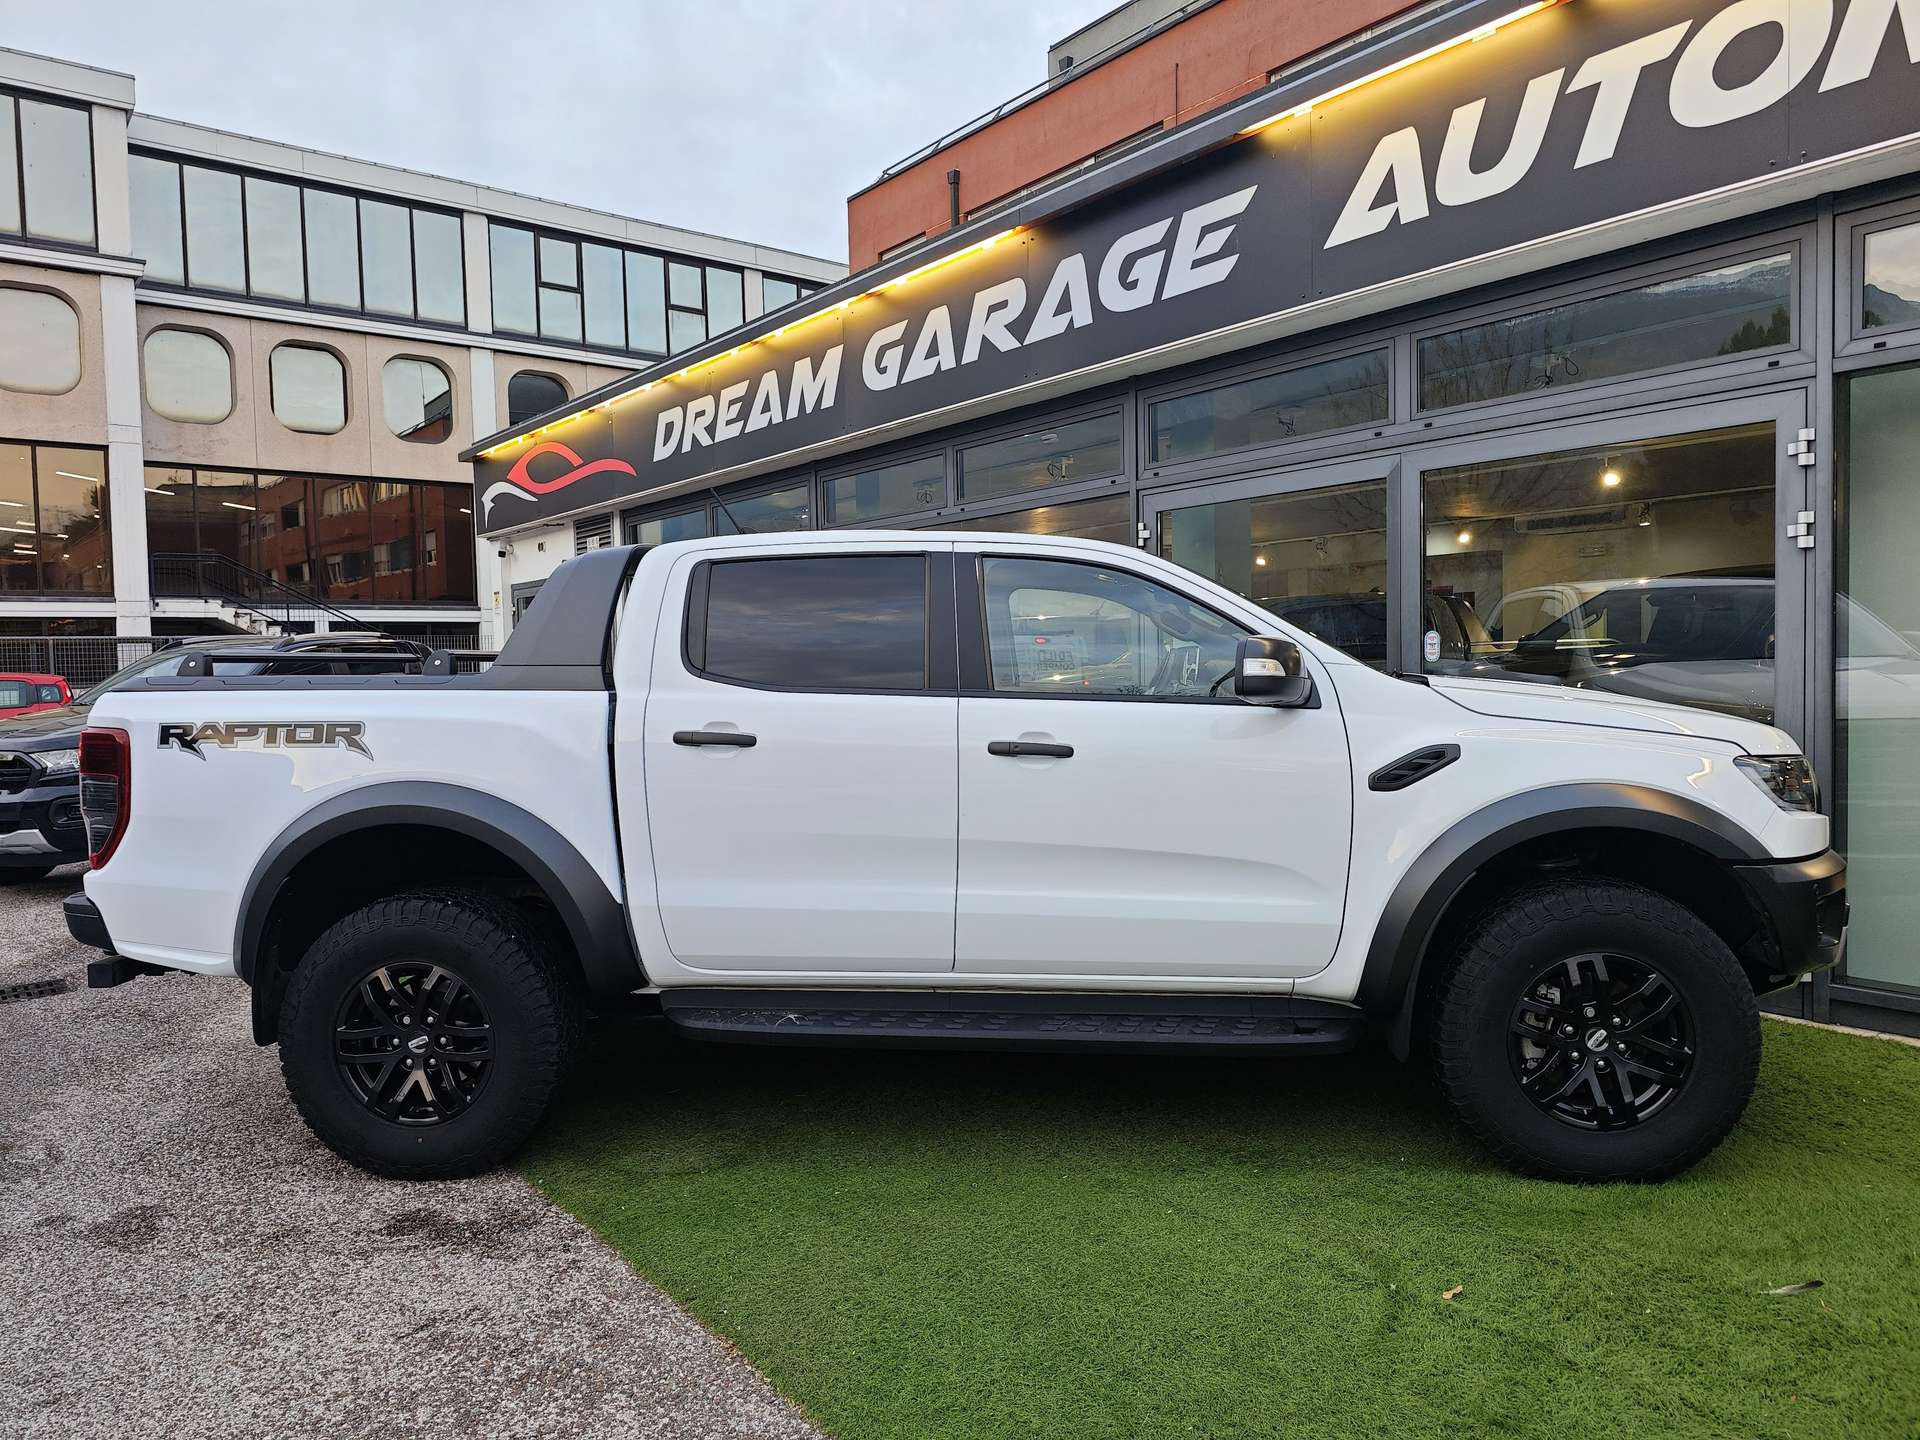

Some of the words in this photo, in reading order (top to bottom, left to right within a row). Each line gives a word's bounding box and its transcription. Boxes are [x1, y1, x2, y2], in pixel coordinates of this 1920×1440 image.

[653, 344, 844, 462] DREAM
[861, 184, 1259, 391] GARAGE
[157, 721, 375, 762] RAPTOR
